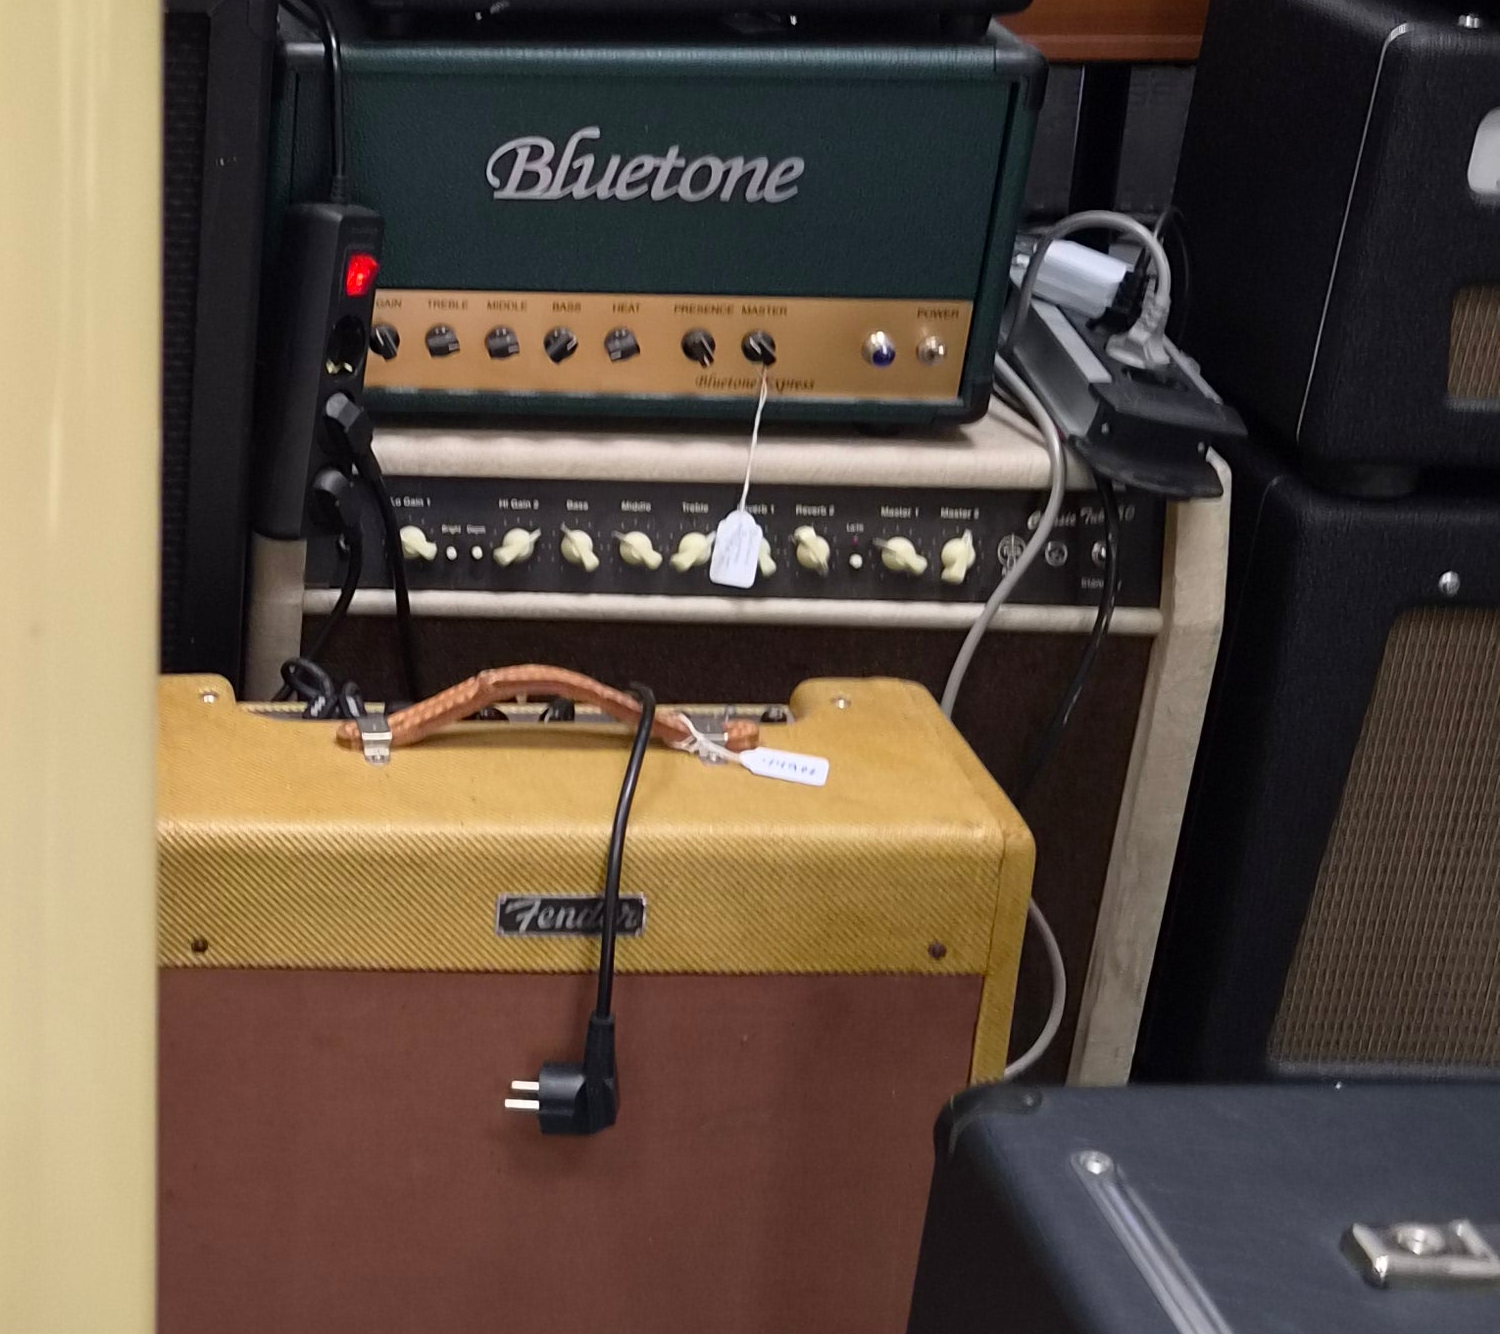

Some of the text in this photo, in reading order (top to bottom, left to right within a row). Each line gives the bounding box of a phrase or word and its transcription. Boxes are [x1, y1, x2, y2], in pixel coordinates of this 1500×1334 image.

[485, 125, 805, 204] Bluetone
[427, 299, 469, 311] TREBLE
[487, 300, 528, 312] MIDDLE
[552, 302, 582, 313] BASS
[612, 303, 641, 314] HEAT
[673, 304, 788, 317] PRESENCE MASTER
[917, 307, 960, 319] POWER
[566, 499, 589, 512] Bass
[621, 500, 652, 513] Middle
[682, 501, 709, 514] Treble
[795, 504, 827, 517] Reverb
[880, 505, 911, 518] Master
[940, 507, 972, 520] Master
[505, 898, 638, 934] Fendr
